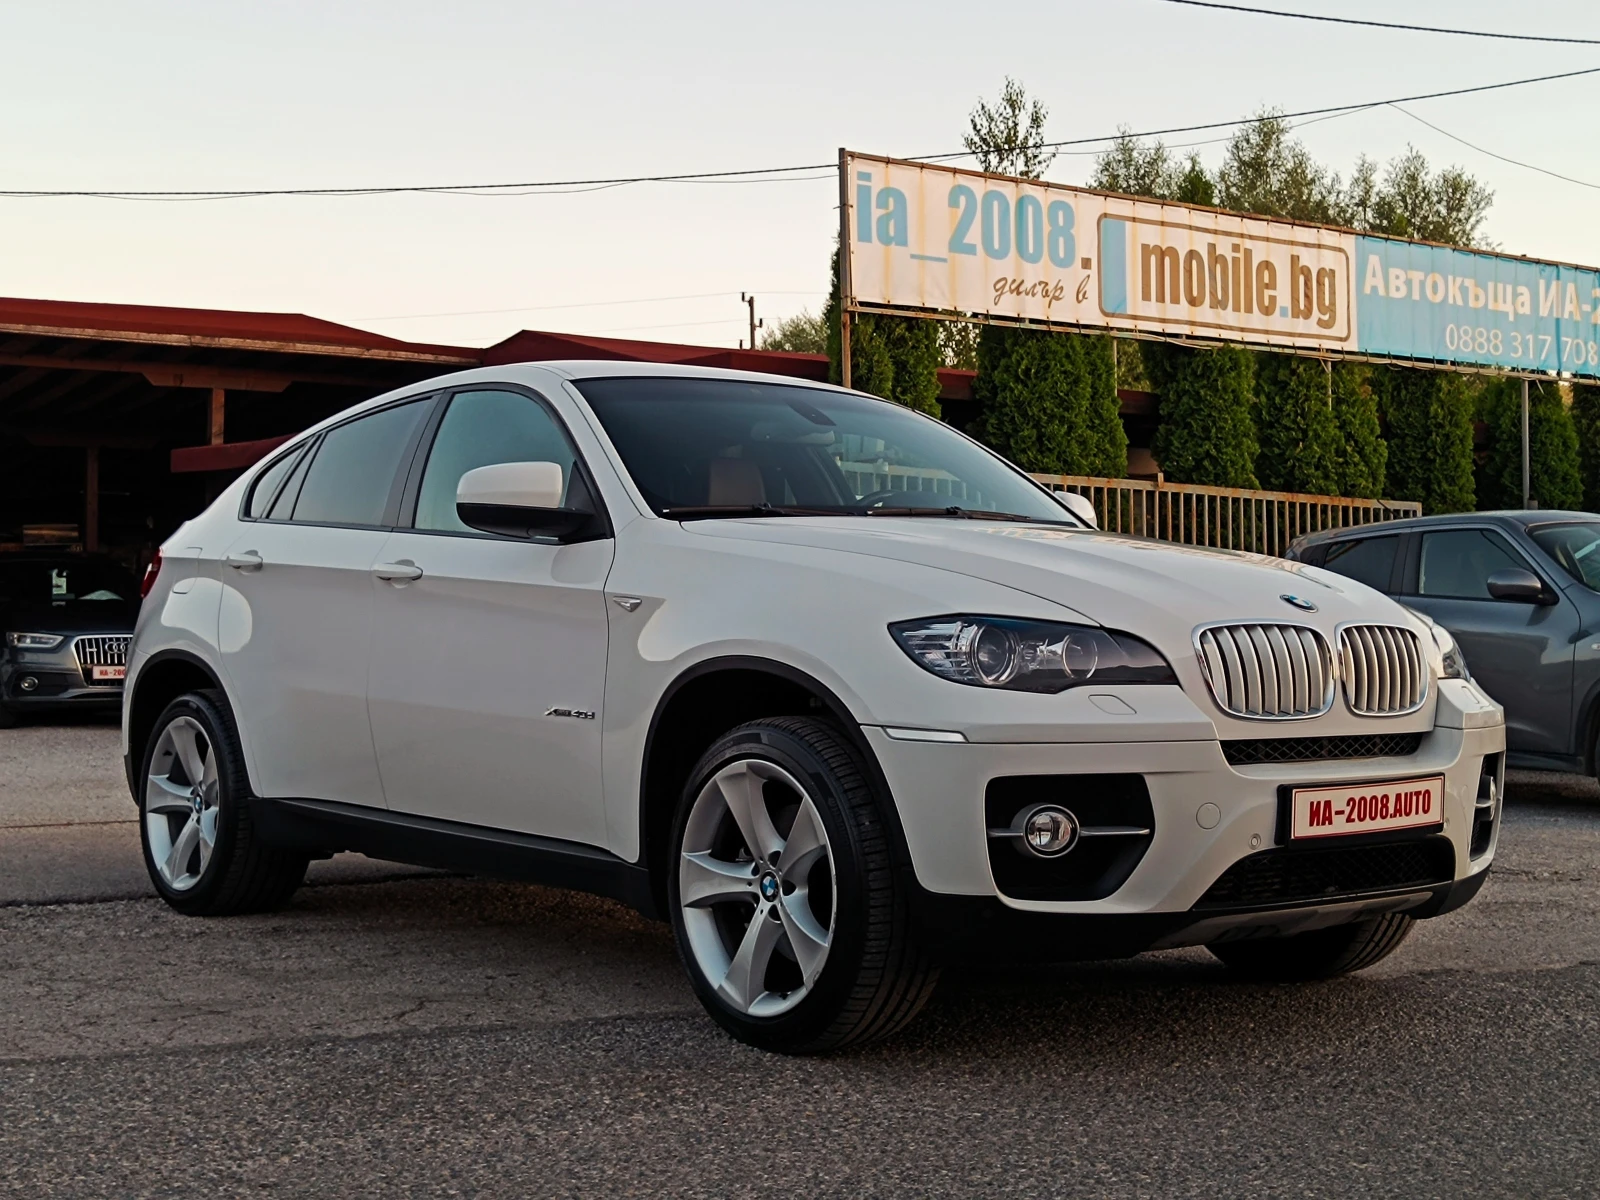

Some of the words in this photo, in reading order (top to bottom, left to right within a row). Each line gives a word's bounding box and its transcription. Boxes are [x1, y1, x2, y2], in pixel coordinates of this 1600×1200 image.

[993, 277, 1065, 308] дилър
[1141, 243, 1337, 329] mobile.bg
[1364, 254, 1531, 321] Автокъща
[1446, 324, 1503, 356] 0888
[1510, 332, 1552, 360] 317
[1561, 336, 1598, 366] 708
[1309, 789, 1431, 827] ИА-2008.AUTO
